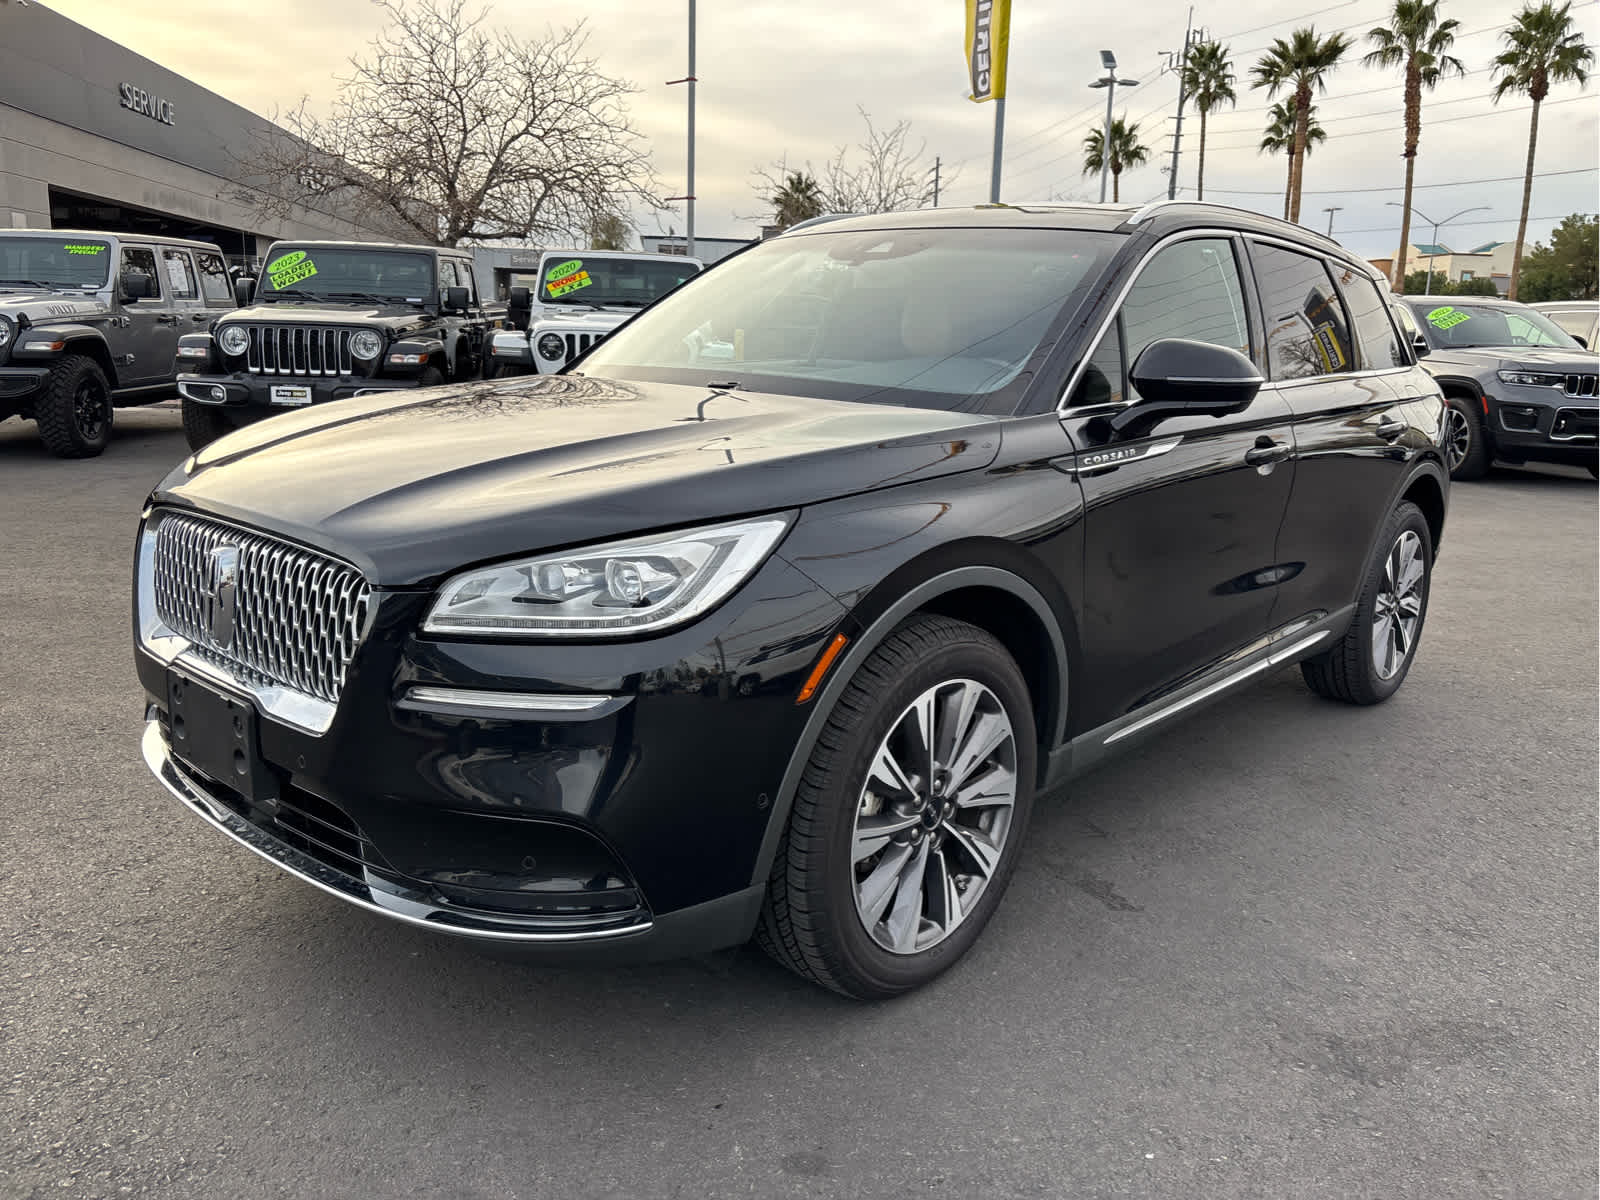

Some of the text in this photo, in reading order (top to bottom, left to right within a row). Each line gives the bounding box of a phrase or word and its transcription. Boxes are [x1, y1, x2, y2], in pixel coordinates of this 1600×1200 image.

[121, 82, 176, 126] SERVICE
[274, 253, 300, 271] 2023
[552, 262, 576, 279] 2020
[272, 261, 312, 282] LOADED
[1083, 448, 1137, 465] CORSAIR
